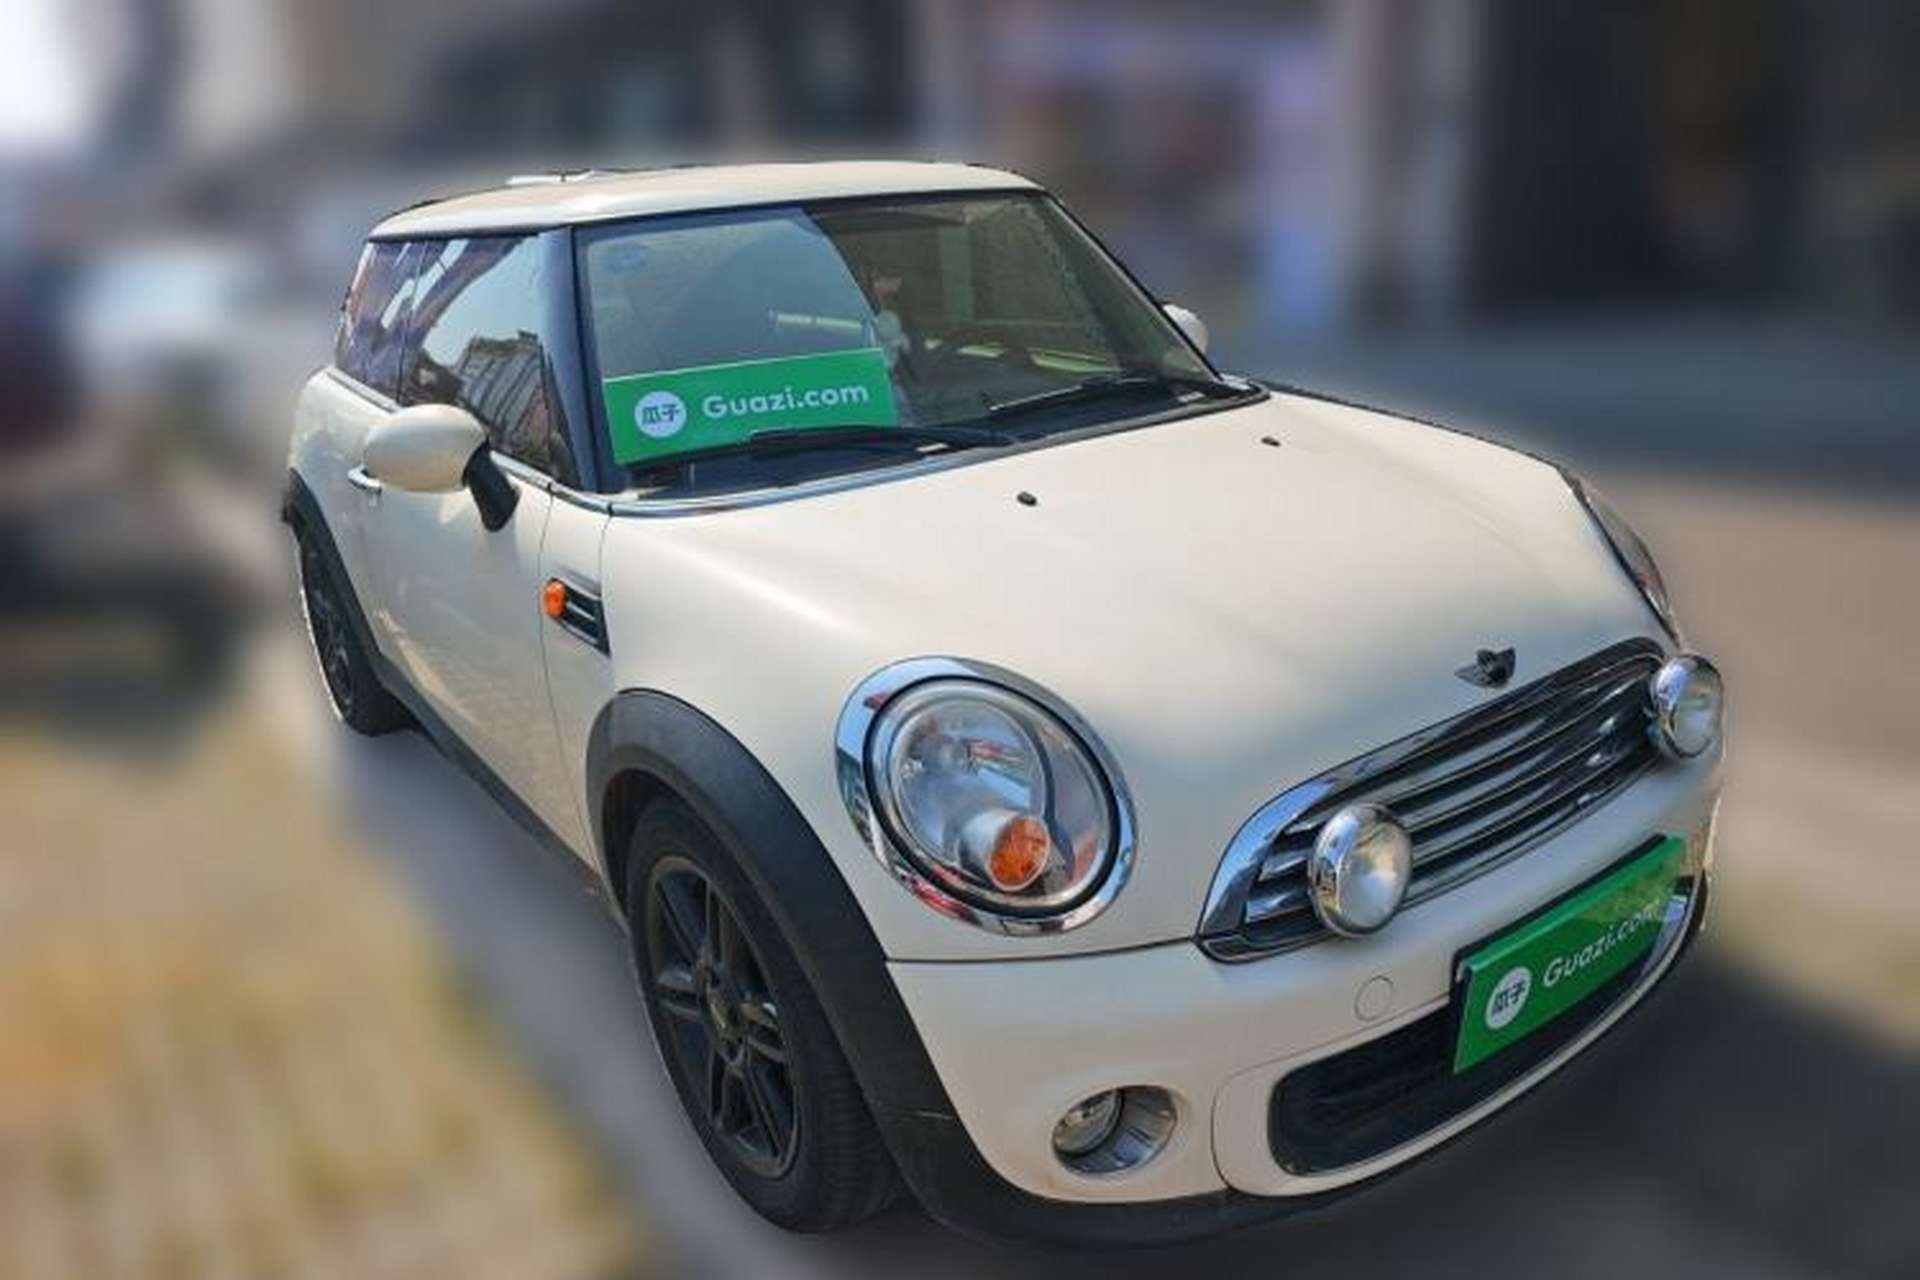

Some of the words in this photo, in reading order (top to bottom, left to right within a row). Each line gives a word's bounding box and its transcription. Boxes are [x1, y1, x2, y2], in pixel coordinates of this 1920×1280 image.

[641, 403, 679, 424] 瓜子
[702, 385, 868, 418] Guazi.com
[1493, 981, 1526, 1014] 瓜子
